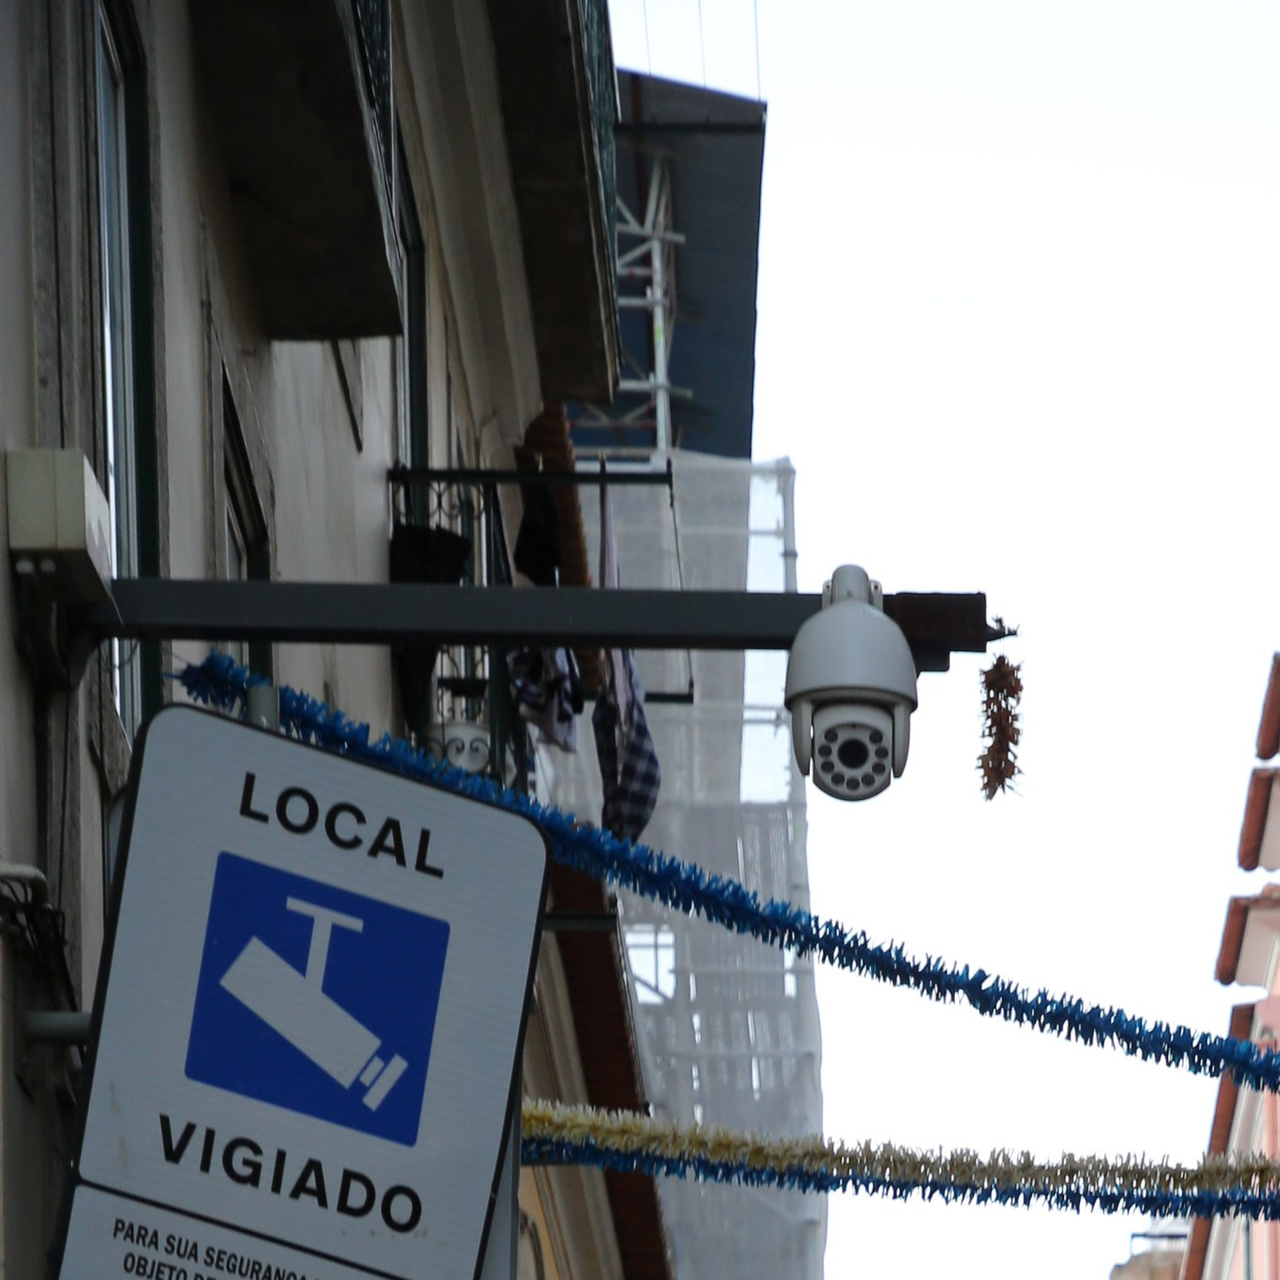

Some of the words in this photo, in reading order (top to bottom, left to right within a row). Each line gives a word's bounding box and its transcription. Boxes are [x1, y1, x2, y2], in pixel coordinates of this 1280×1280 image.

[239, 771, 444, 879] LOCAL
[159, 1113, 422, 1233] VIGIADO
[113, 1218, 159, 1250] PARA
[164, 1234, 198, 1263] SUA
